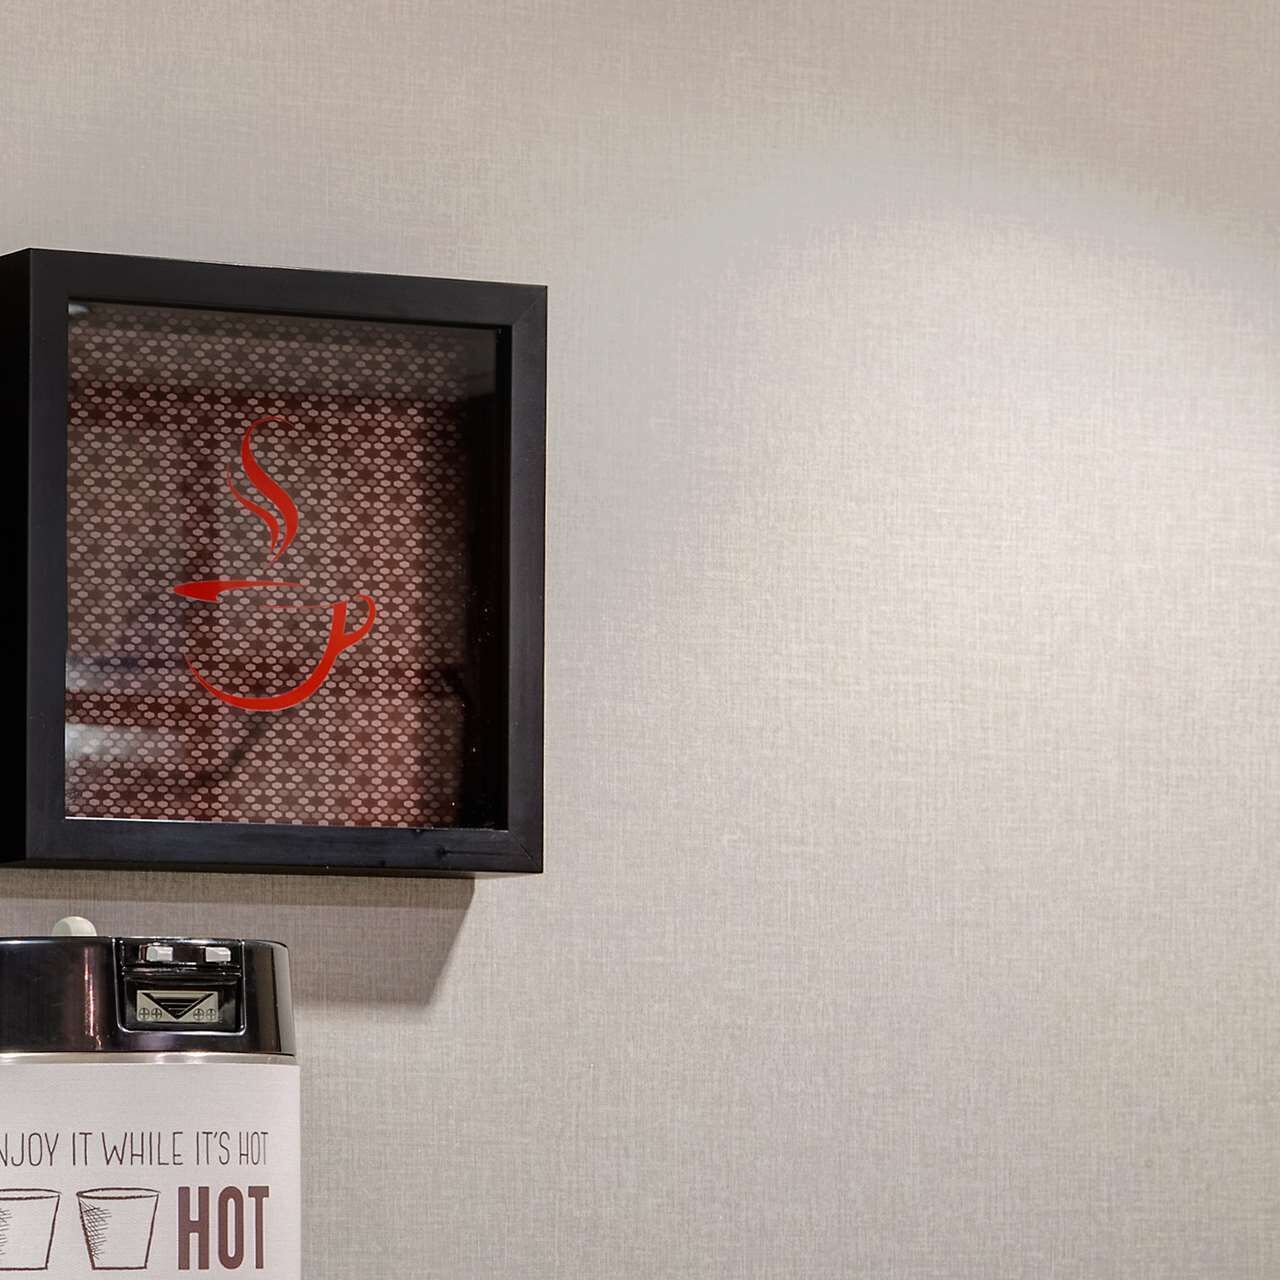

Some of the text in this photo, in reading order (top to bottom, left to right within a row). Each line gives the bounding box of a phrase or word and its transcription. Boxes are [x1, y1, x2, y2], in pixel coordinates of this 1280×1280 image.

[73, 1132, 92, 1166] IT
[102, 1132, 183, 1165] WHILE
[197, 1131, 230, 1165] IT'S
[239, 1132, 268, 1165] HOT
[178, 1186, 269, 1270] HOT
